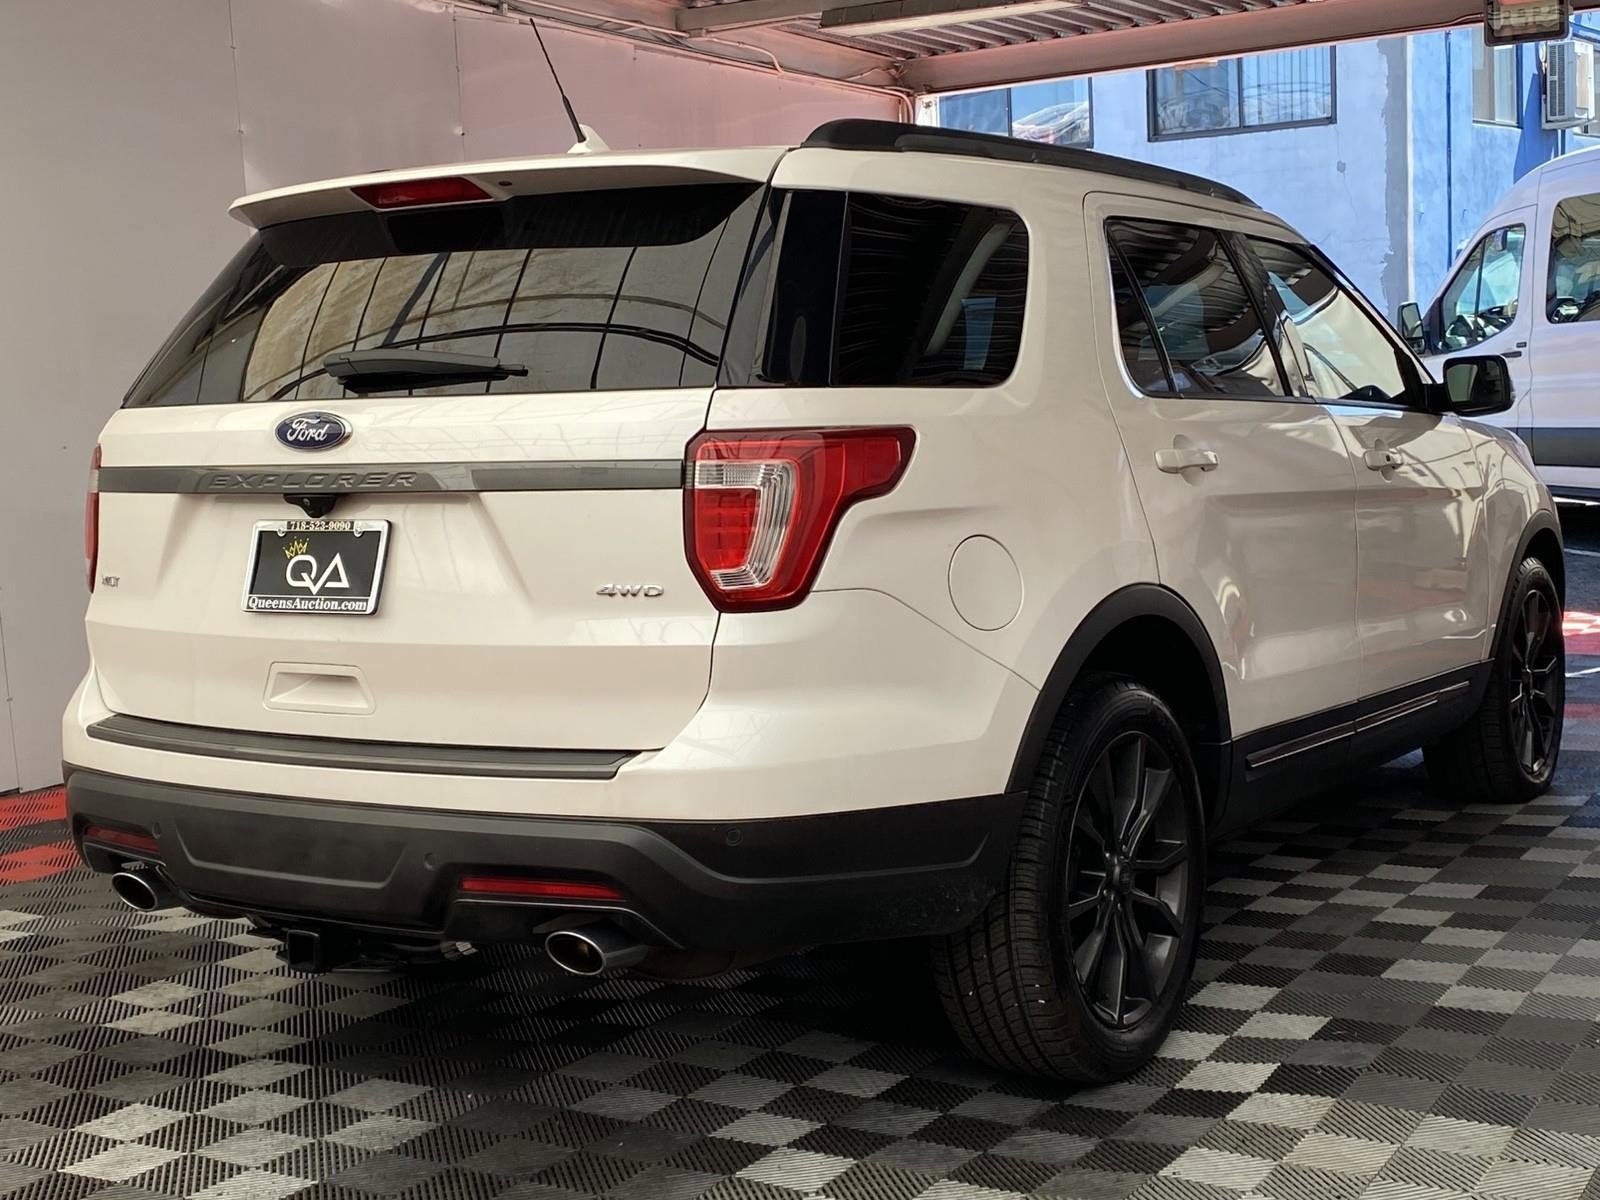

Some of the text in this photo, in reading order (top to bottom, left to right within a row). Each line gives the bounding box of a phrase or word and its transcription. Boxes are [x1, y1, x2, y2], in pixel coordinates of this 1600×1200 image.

[286, 418, 327, 441] Ford
[208, 472, 417, 488] EXPLORER
[596, 583, 664, 597] 4WD
[248, 596, 367, 611] QueensAuction.com
